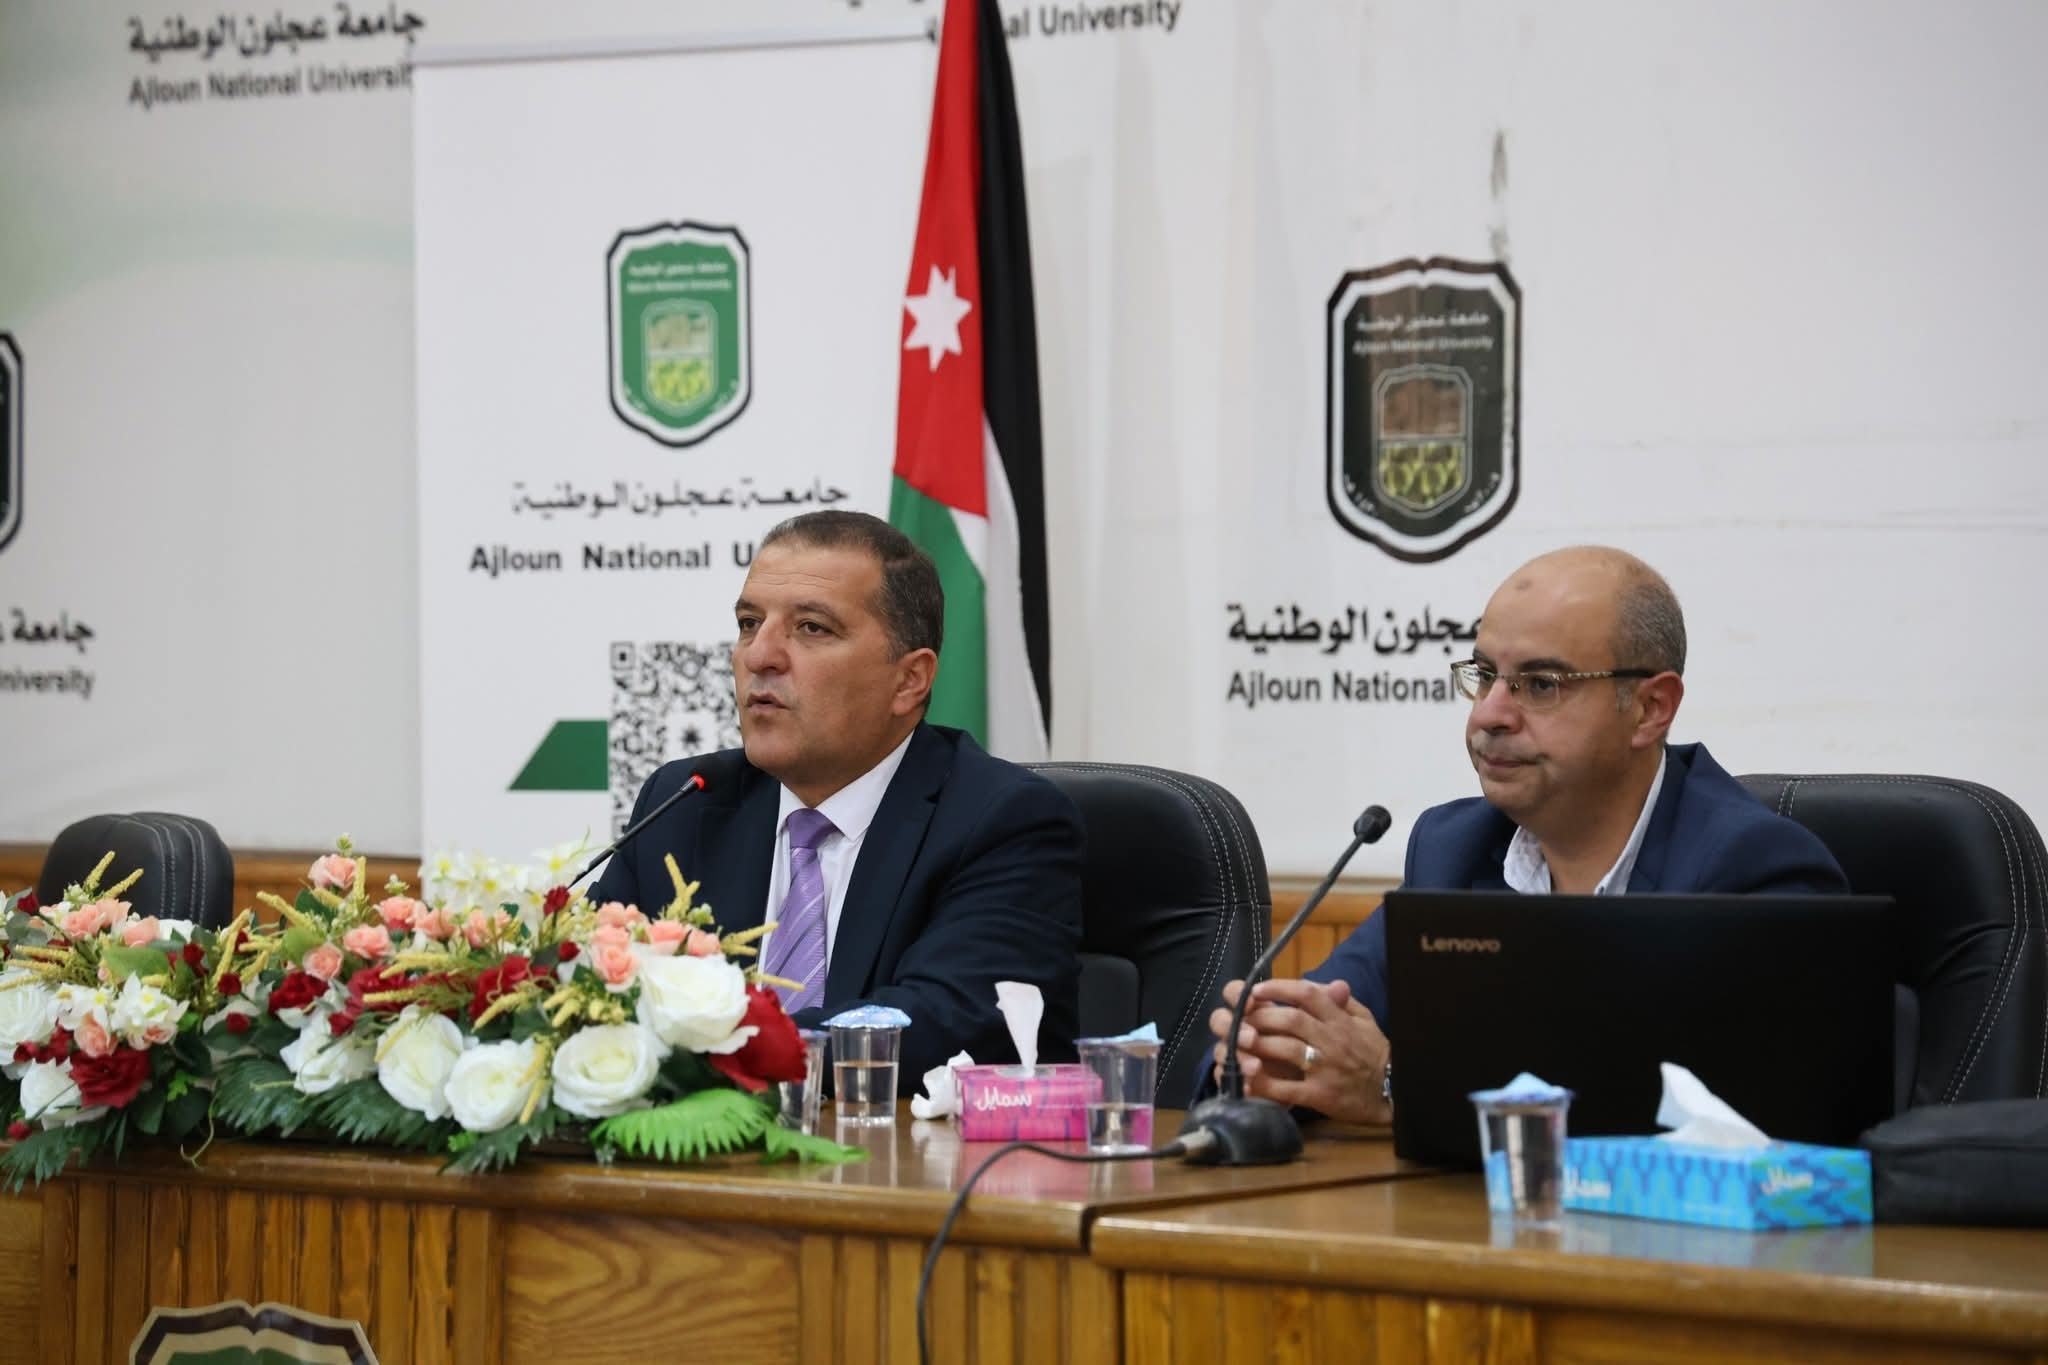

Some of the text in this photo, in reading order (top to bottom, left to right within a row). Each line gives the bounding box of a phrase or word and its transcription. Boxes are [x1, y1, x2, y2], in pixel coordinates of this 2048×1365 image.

[128, 1, 423, 62] جامعة عجلون الوطنية
[1038, 0, 1181, 37] University
[130, 77, 198, 109] Ajloun
[208, 68, 299, 100] National
[512, 477, 848, 519] جامعة عجلون الوطنية
[470, 544, 562, 577] Ajloun
[583, 542, 711, 569] National
[12, 606, 95, 654] جامعة
[1227, 602, 1369, 655] الوطنية
[0, 667, 95, 700] niversity
[1228, 669, 1455, 707] Ajloun National
[1421, 935, 1501, 953] Lenovo
[973, 1086, 1033, 1112] سمايل
